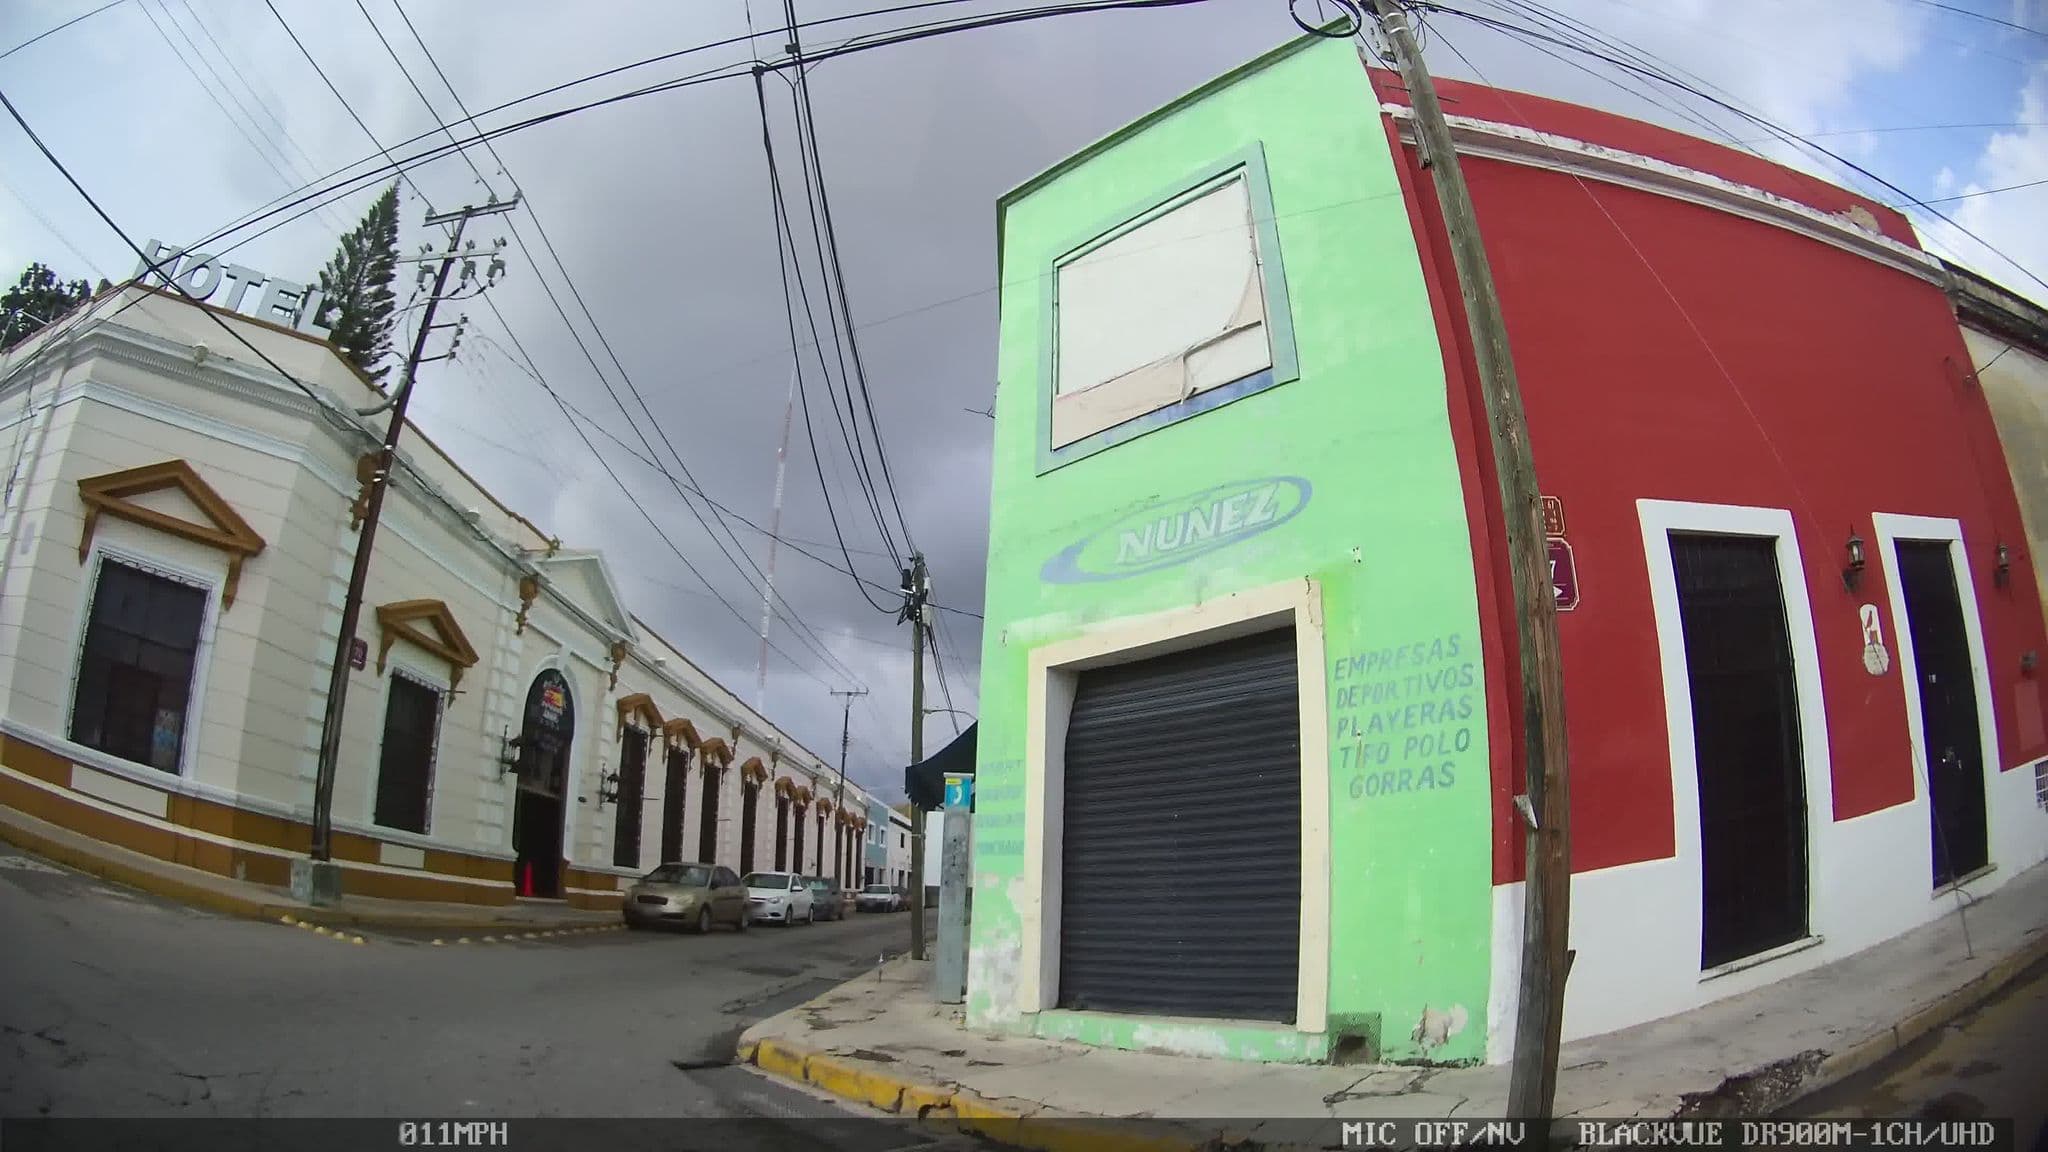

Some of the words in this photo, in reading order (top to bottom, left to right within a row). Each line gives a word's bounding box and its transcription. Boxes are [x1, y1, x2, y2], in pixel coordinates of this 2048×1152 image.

[132, 238, 333, 341] HOTEL
[1334, 634, 1461, 681] EMPRESAS
[1336, 663, 1474, 709] DEPORTIVOS
[1336, 695, 1473, 740] PLAYERAS
[1404, 728, 1471, 760] POLO
[1350, 761, 1456, 799] GORRAS
